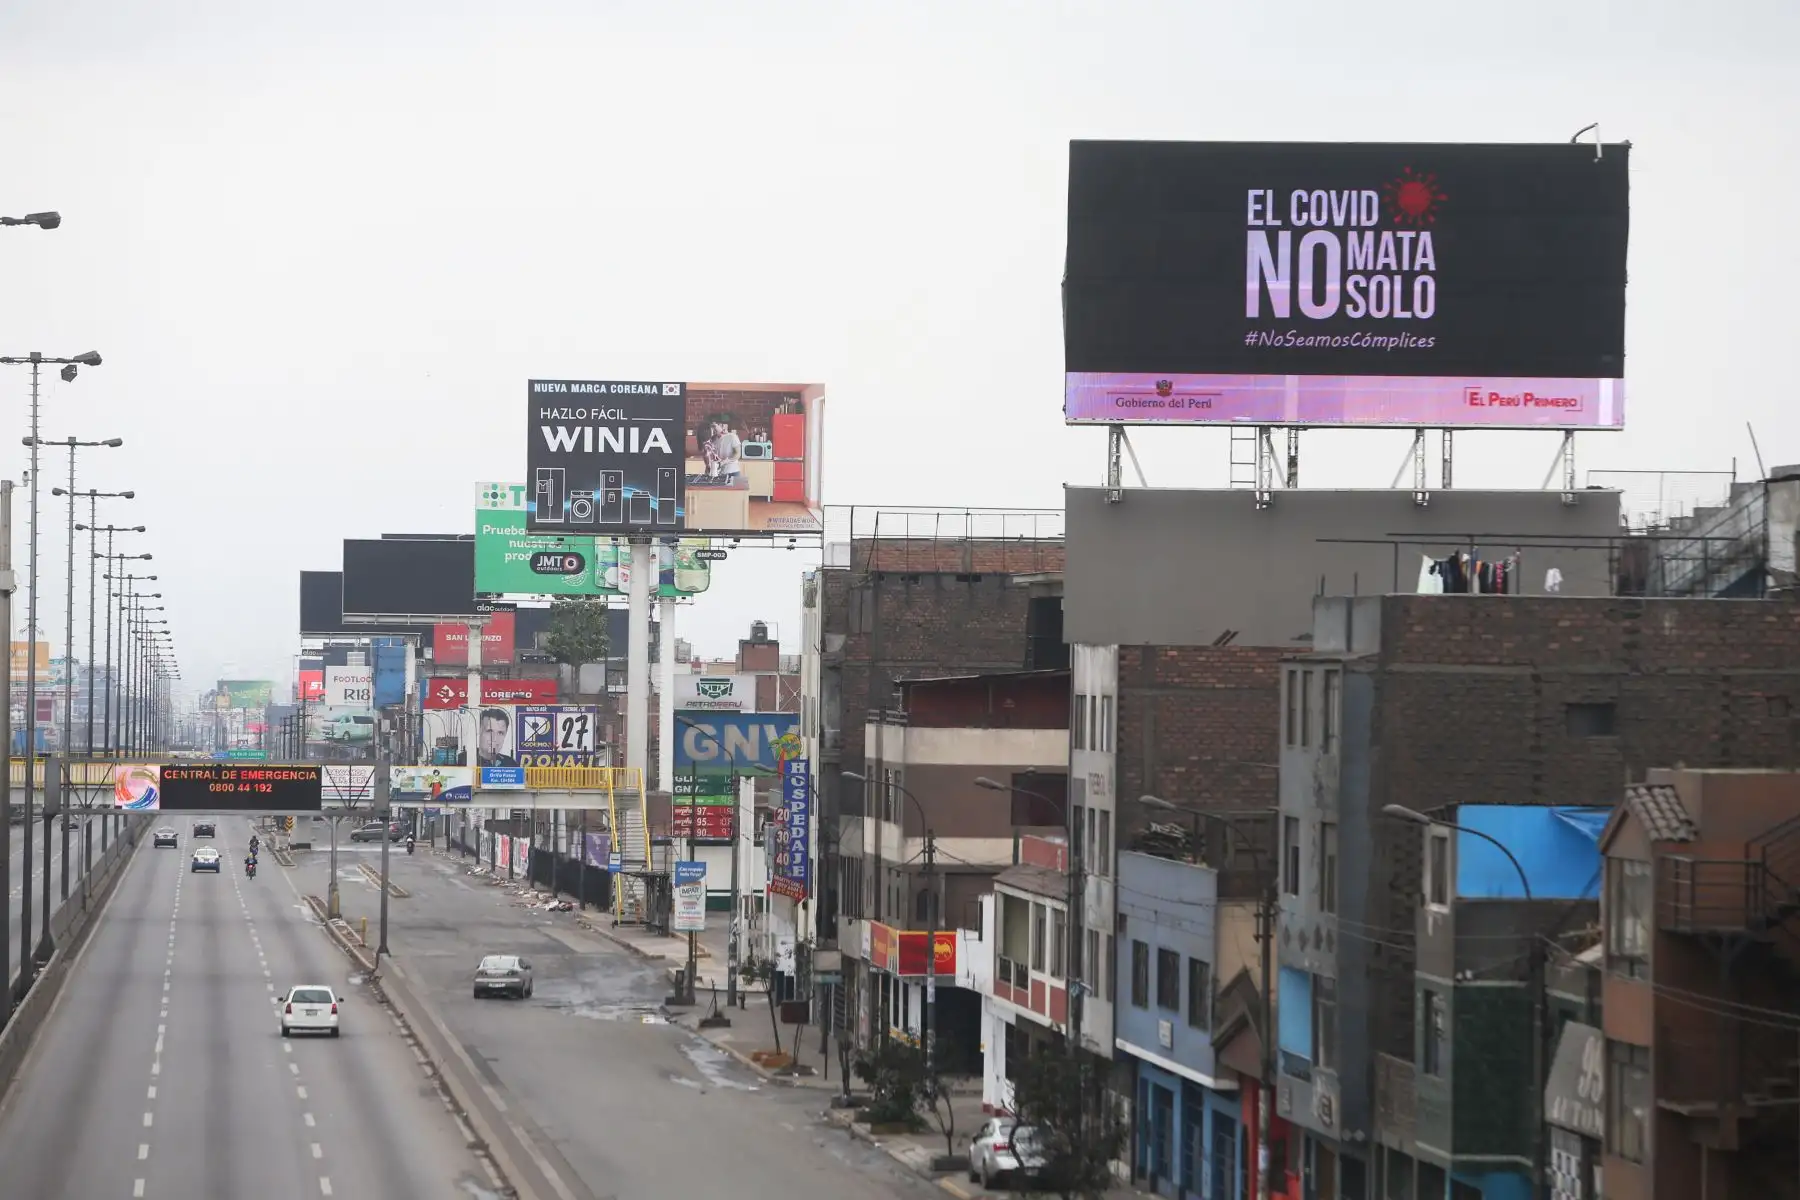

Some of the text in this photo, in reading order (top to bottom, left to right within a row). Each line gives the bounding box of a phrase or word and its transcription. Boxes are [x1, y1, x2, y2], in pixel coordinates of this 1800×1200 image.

[1248, 189, 1379, 227] EL COVID
[1245, 229, 1436, 320] NO MATA
[1346, 274, 1436, 319] SOLO
[1245, 329, 1436, 351] #NoSeamosCómplices
[534, 384, 659, 395] NUEVA MARCA COREANA
[1115, 397, 1212, 408] Gobierno del Perú
[540, 405, 628, 420] HAZLO FÁCIL
[541, 426, 673, 454] WINIA
[504, 551, 532, 563] prod
[537, 556, 563, 567] JMT
[344, 689, 371, 701] R18
[562, 714, 589, 750] 27
[164, 770, 219, 780] CENTRAL
[222, 770, 237, 780] DE
[241, 770, 317, 780] EMERGENCIA
[209, 784, 273, 793] 0800 44 192
[696, 807, 708, 816] 97
[776, 808, 790, 822] 20
[696, 817, 708, 826] 95
[790, 762, 807, 878] HOSPEDAJE
[696, 828, 708, 837] 90
[776, 830, 790, 844] 30
[776, 852, 790, 866] 40
